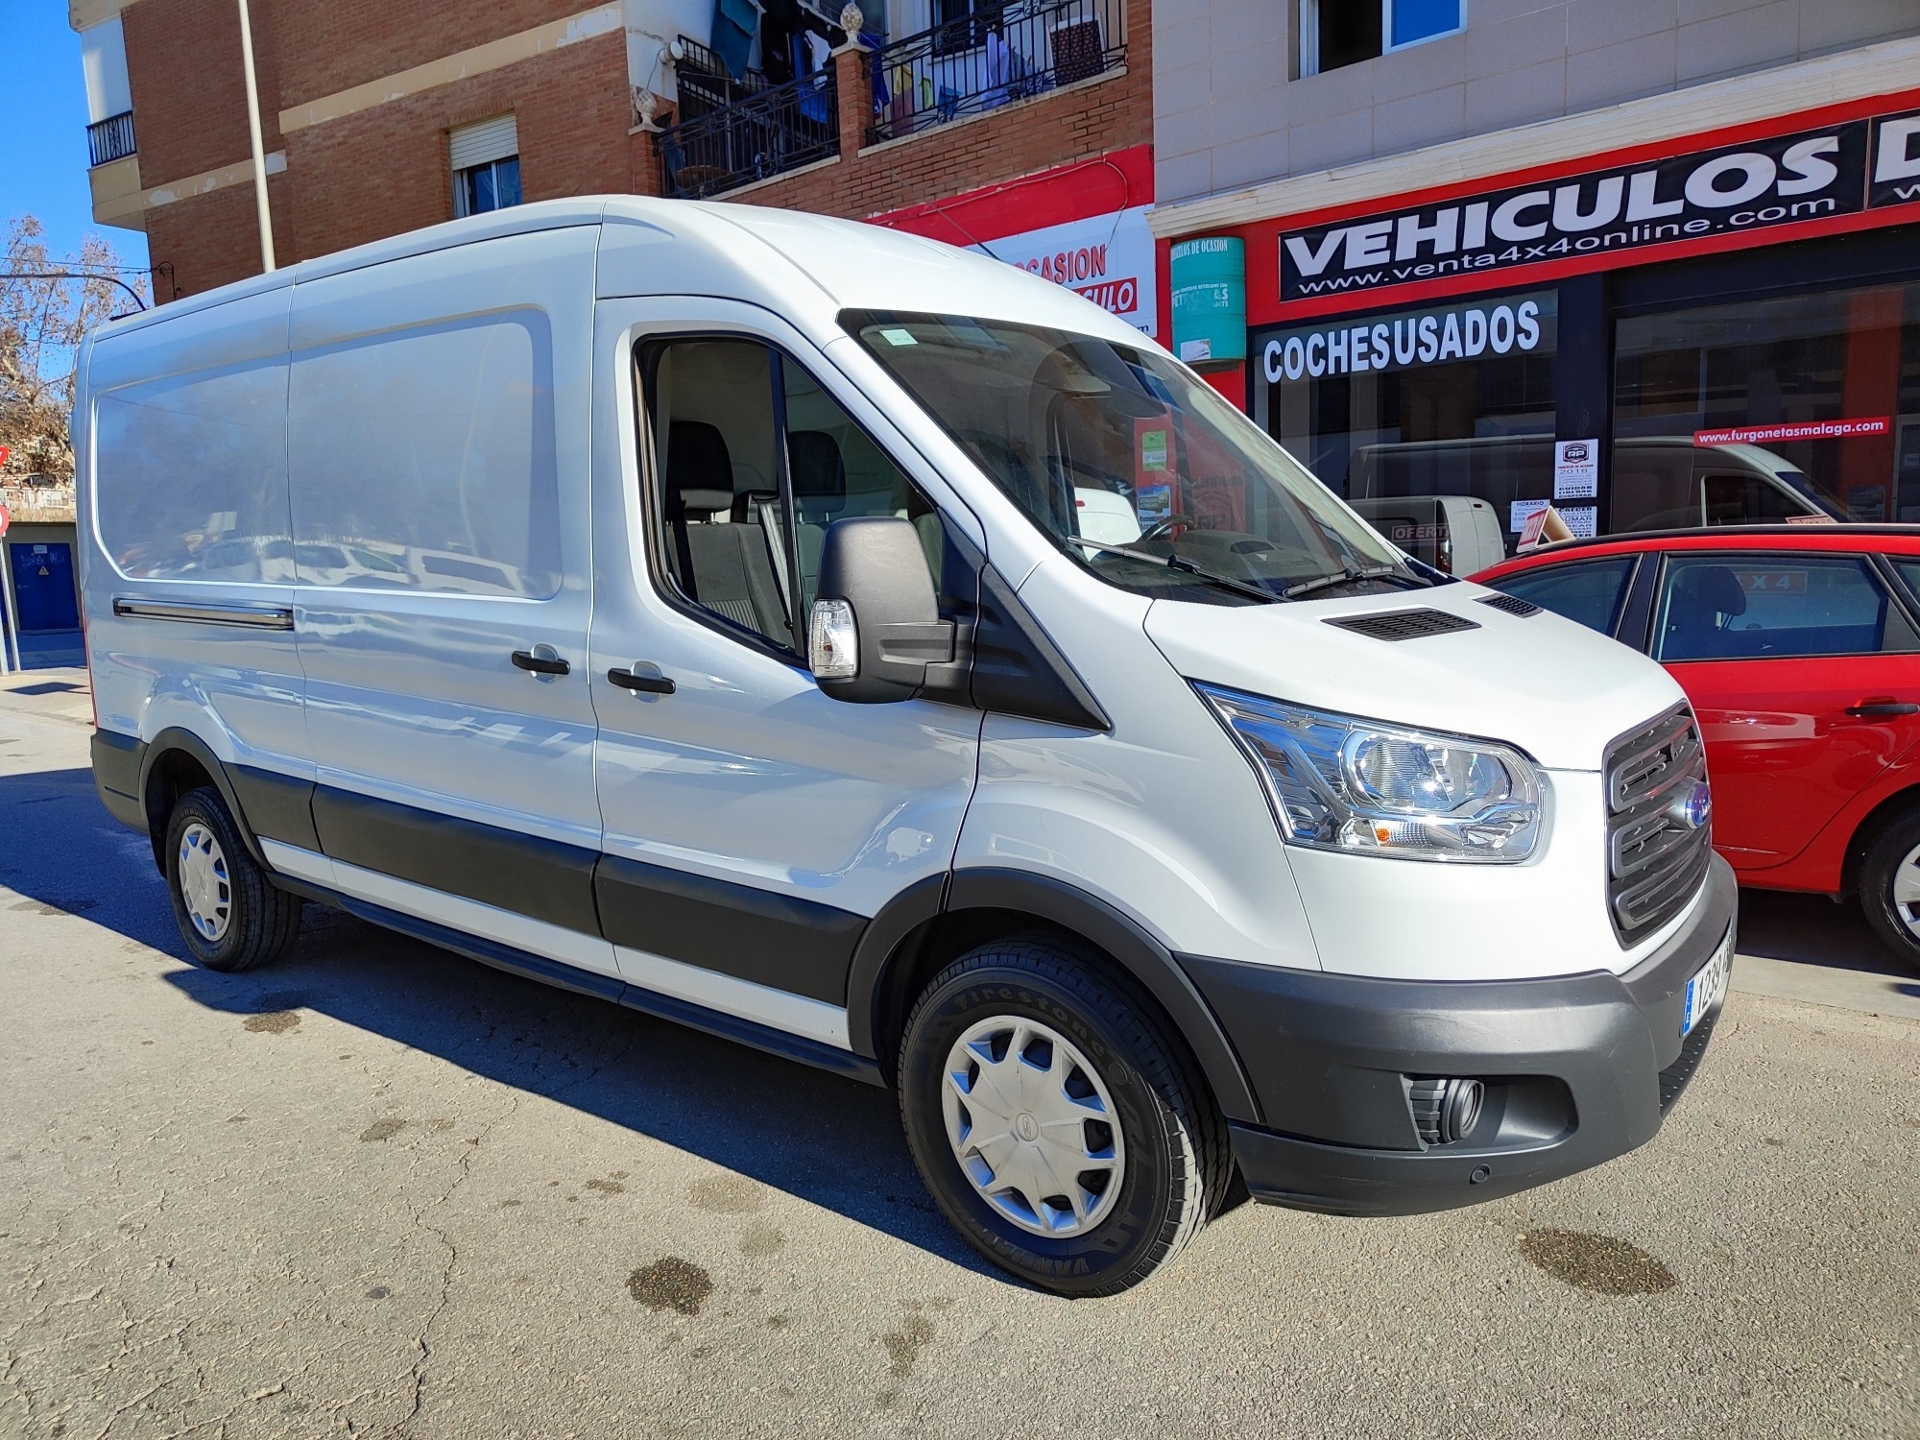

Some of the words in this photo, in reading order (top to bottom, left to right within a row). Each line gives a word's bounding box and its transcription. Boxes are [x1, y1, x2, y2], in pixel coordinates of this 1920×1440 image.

[1284, 135, 1839, 277] VEHICULOS
[1014, 243, 1106, 285] ASION
[1201, 239, 1228, 253] OCASION
[1298, 197, 1835, 294] www.venta4x4online.com
[1699, 420, 1884, 443] www.furgonetasmalaga.com
[954, 986, 1105, 1056] Firestone
